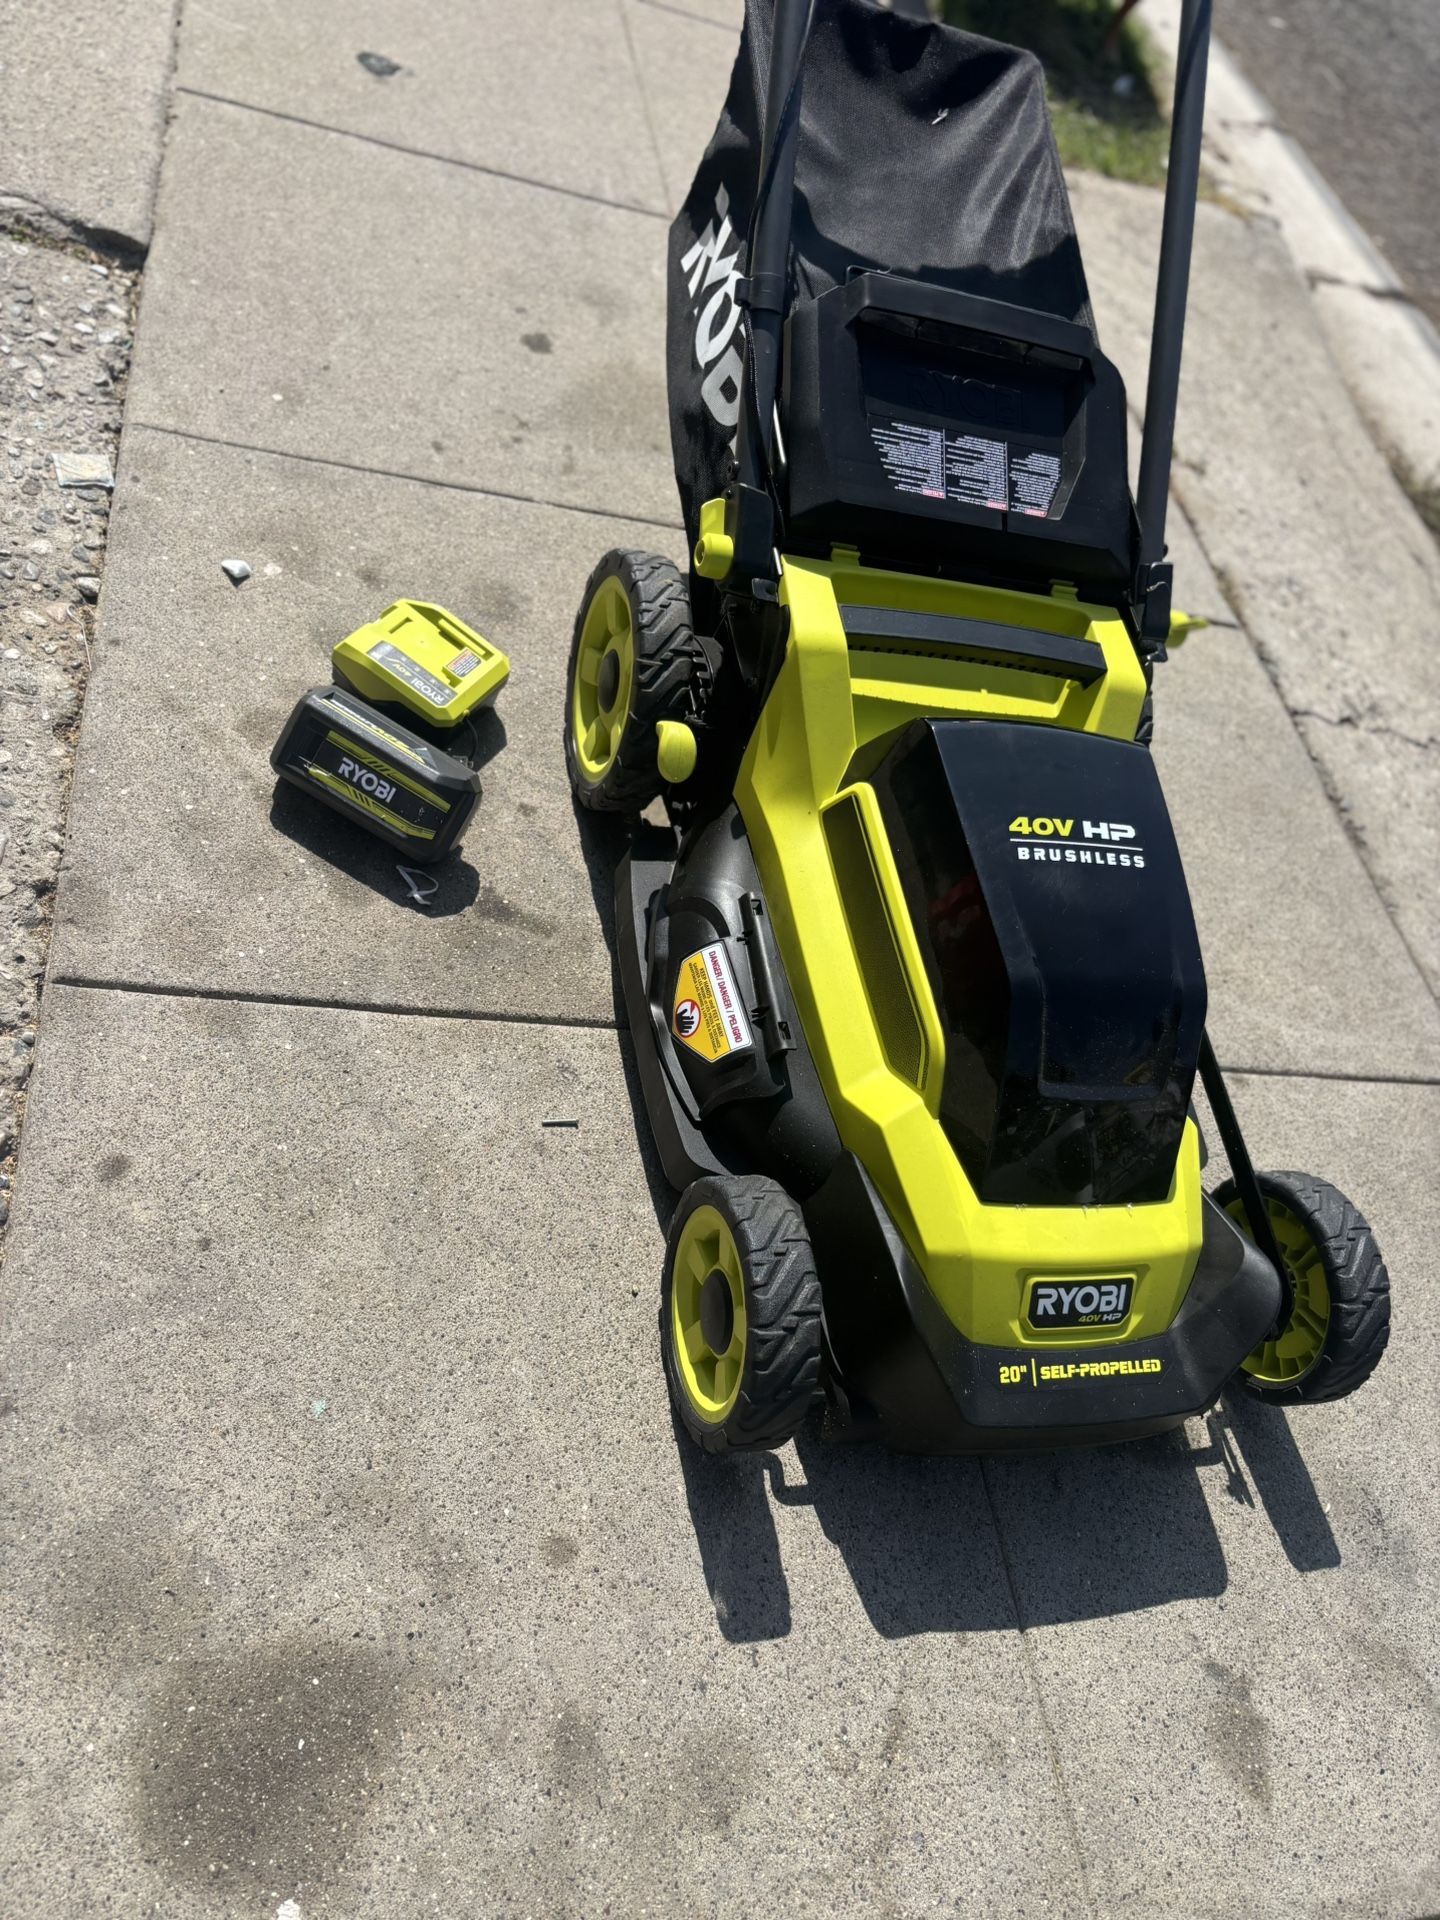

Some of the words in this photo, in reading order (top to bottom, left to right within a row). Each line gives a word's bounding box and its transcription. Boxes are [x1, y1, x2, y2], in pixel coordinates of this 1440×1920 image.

[411, 678, 445, 705] RYOBI
[338, 757, 397, 803] RYOBI
[1008, 816, 1074, 836] 40V
[1082, 820, 1136, 841] HP
[1017, 847, 1145, 868] BRUSHLESS
[718, 981, 732, 1009] DANGER
[728, 1014, 743, 1043] PELIGRO
[1036, 1284, 1127, 1315] RYOBI
[1078, 1314, 1102, 1323] 40V
[1102, 1313, 1122, 1322] HP
[1000, 1365, 1027, 1384] 20"
[1040, 1359, 1161, 1380] SELF-PROPELLED
